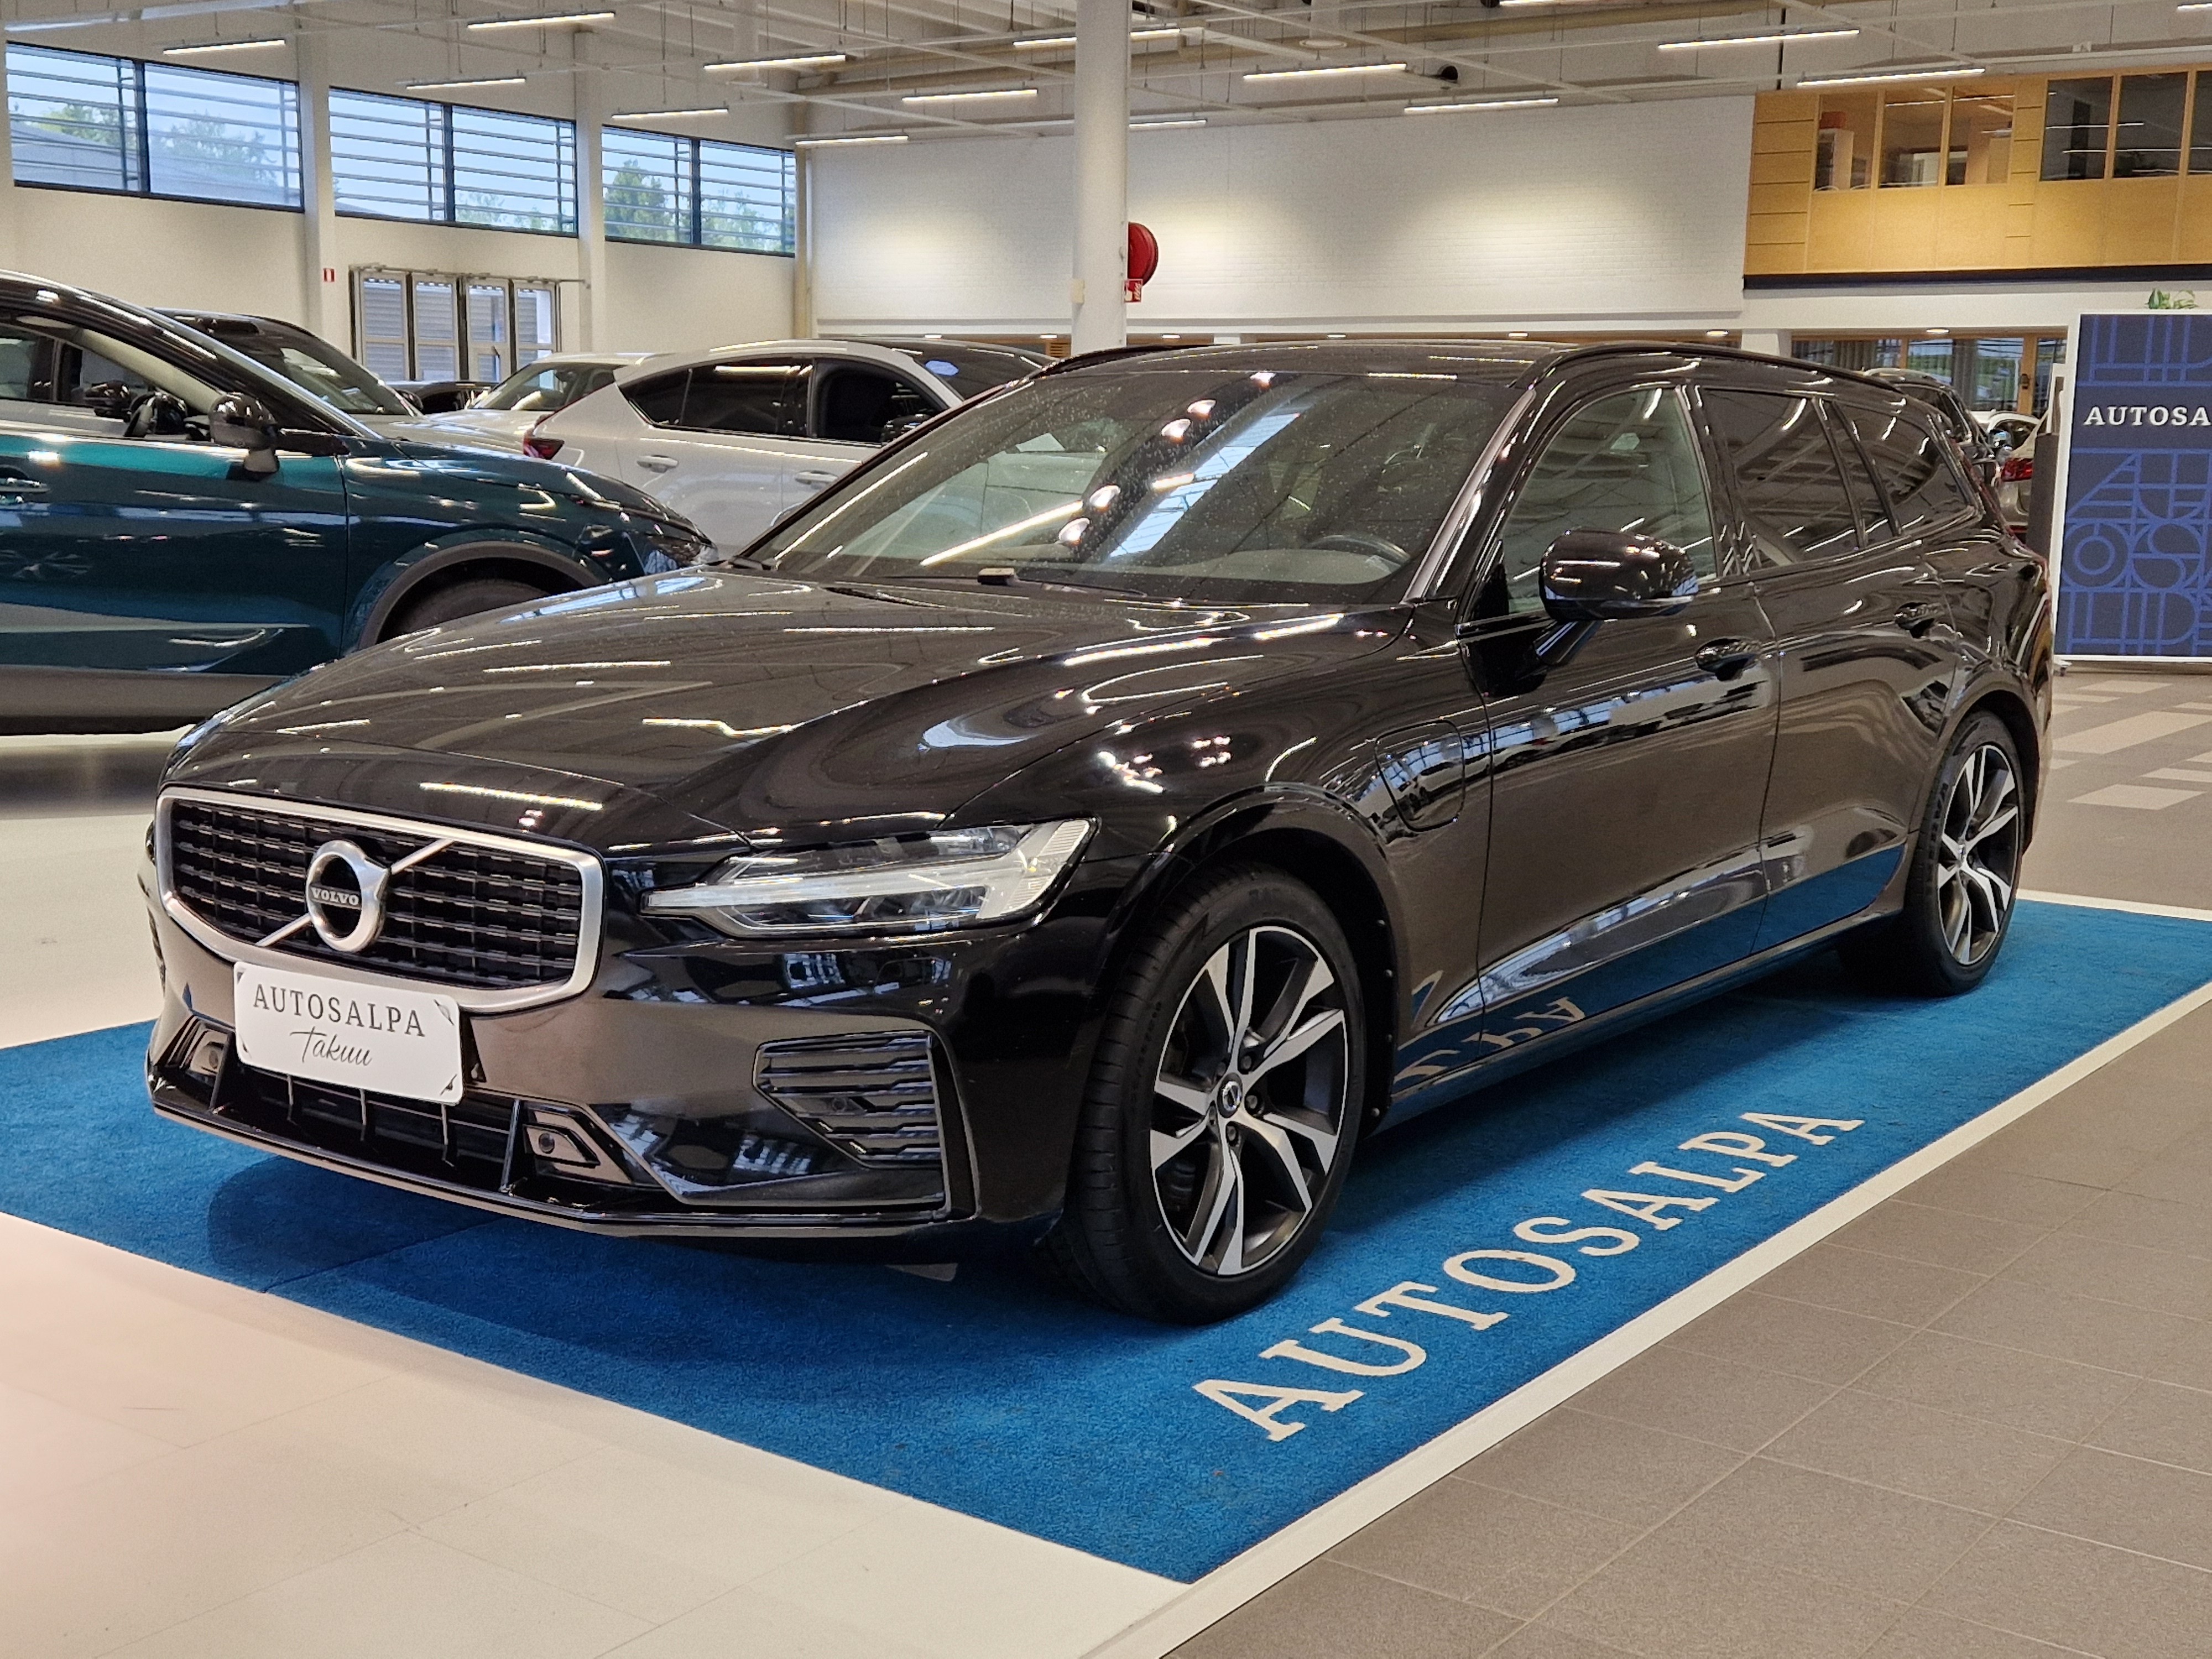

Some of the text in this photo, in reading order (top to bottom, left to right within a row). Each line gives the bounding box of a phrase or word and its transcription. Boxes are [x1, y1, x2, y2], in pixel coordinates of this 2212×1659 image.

[2083, 406, 2211, 426] AUTOSA
[310, 887, 359, 906] VOLVO
[253, 983, 425, 1037] AUTOSALPA
[289, 1026, 372, 1066] Takuu
[1193, 1112, 1865, 1442] AUTOSALPA
